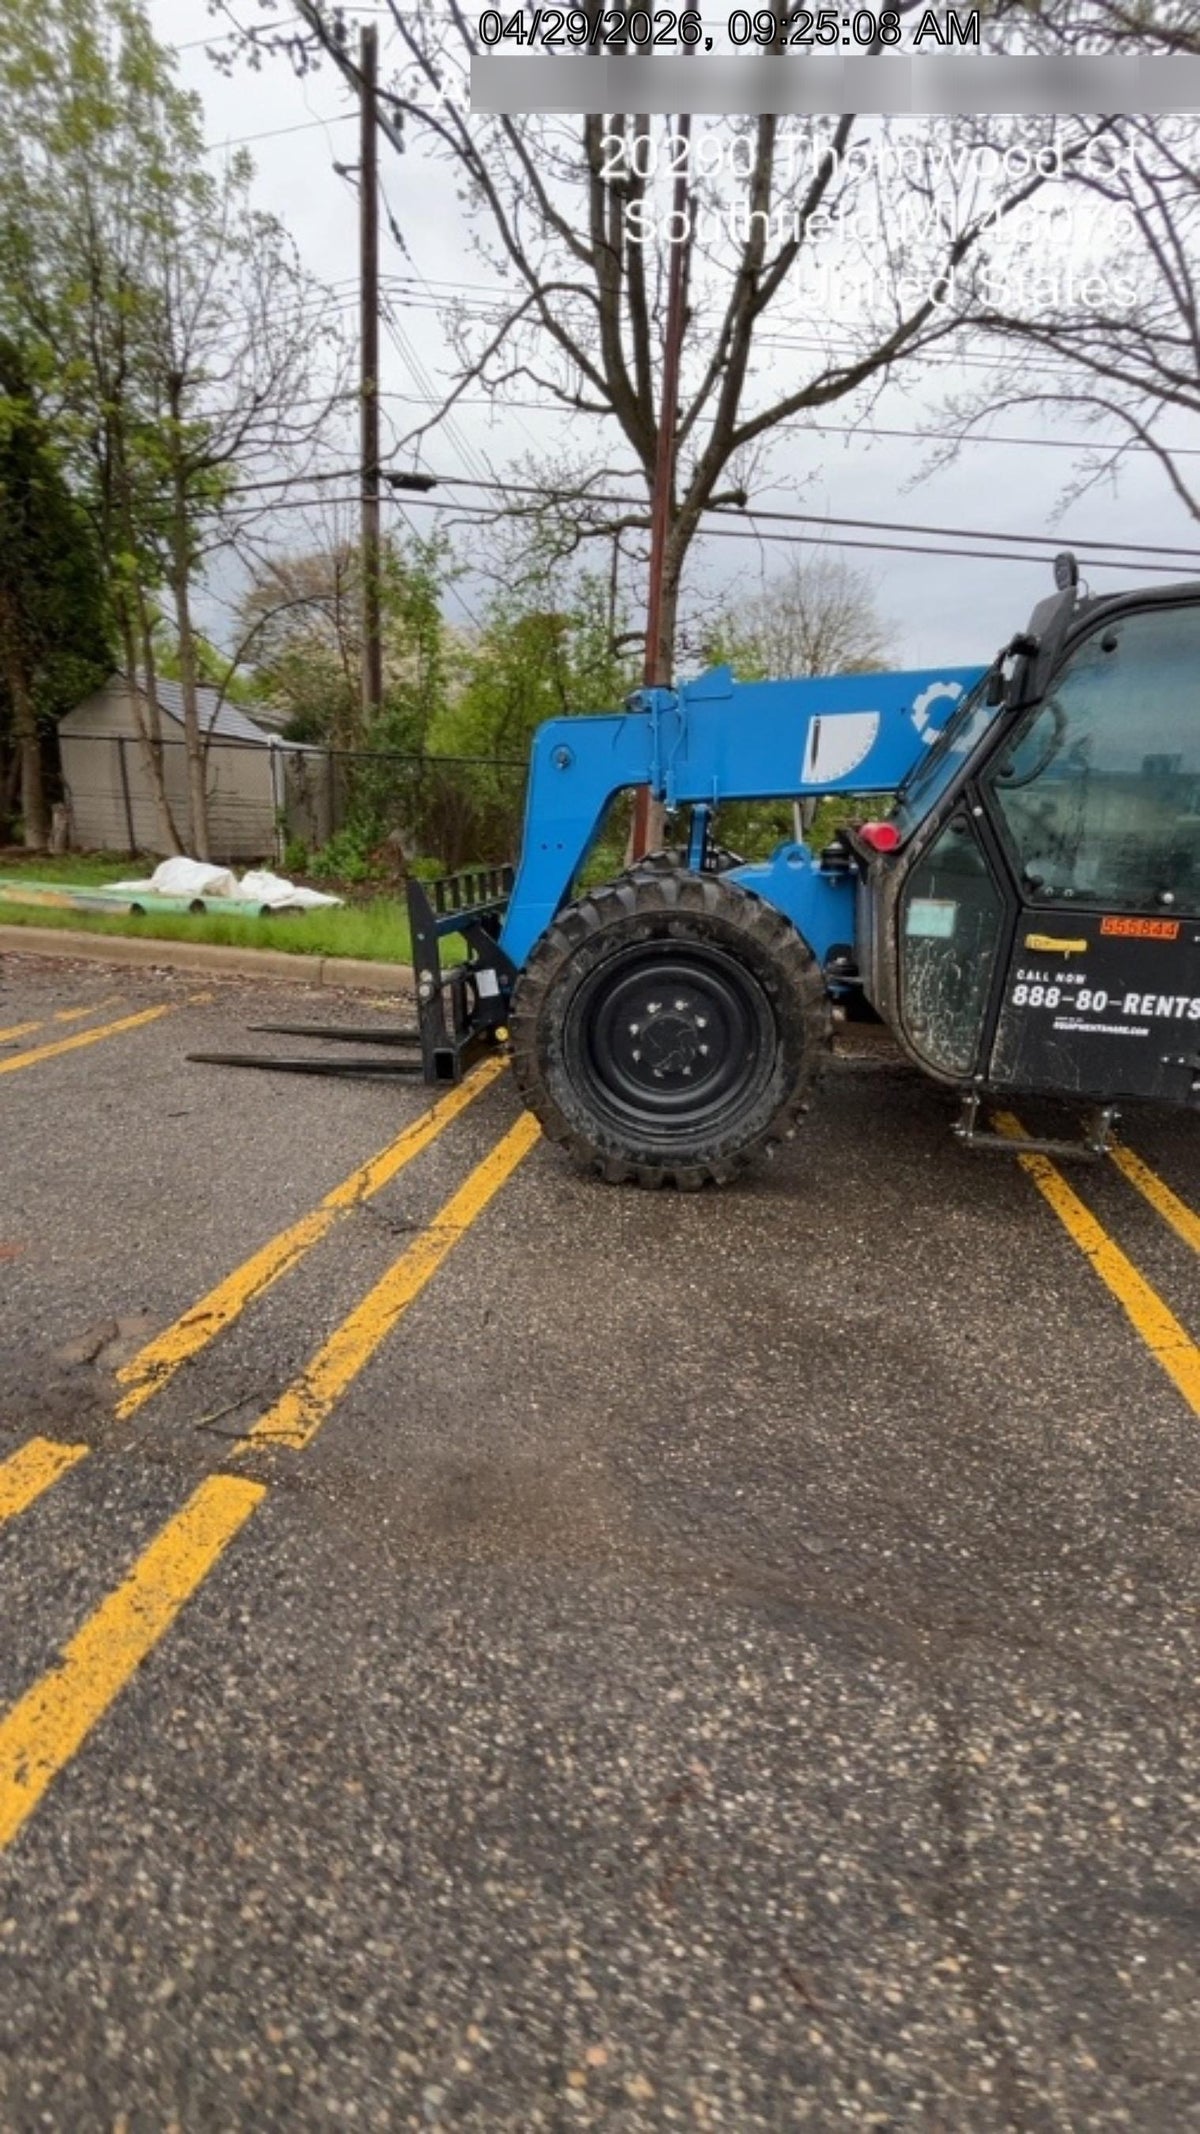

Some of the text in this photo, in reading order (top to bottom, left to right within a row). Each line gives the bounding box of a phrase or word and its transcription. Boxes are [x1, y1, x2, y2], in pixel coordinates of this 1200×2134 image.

[1016, 969, 1087, 984] CALL NOW
[1012, 984, 1200, 1019] 888-80-RENTS
